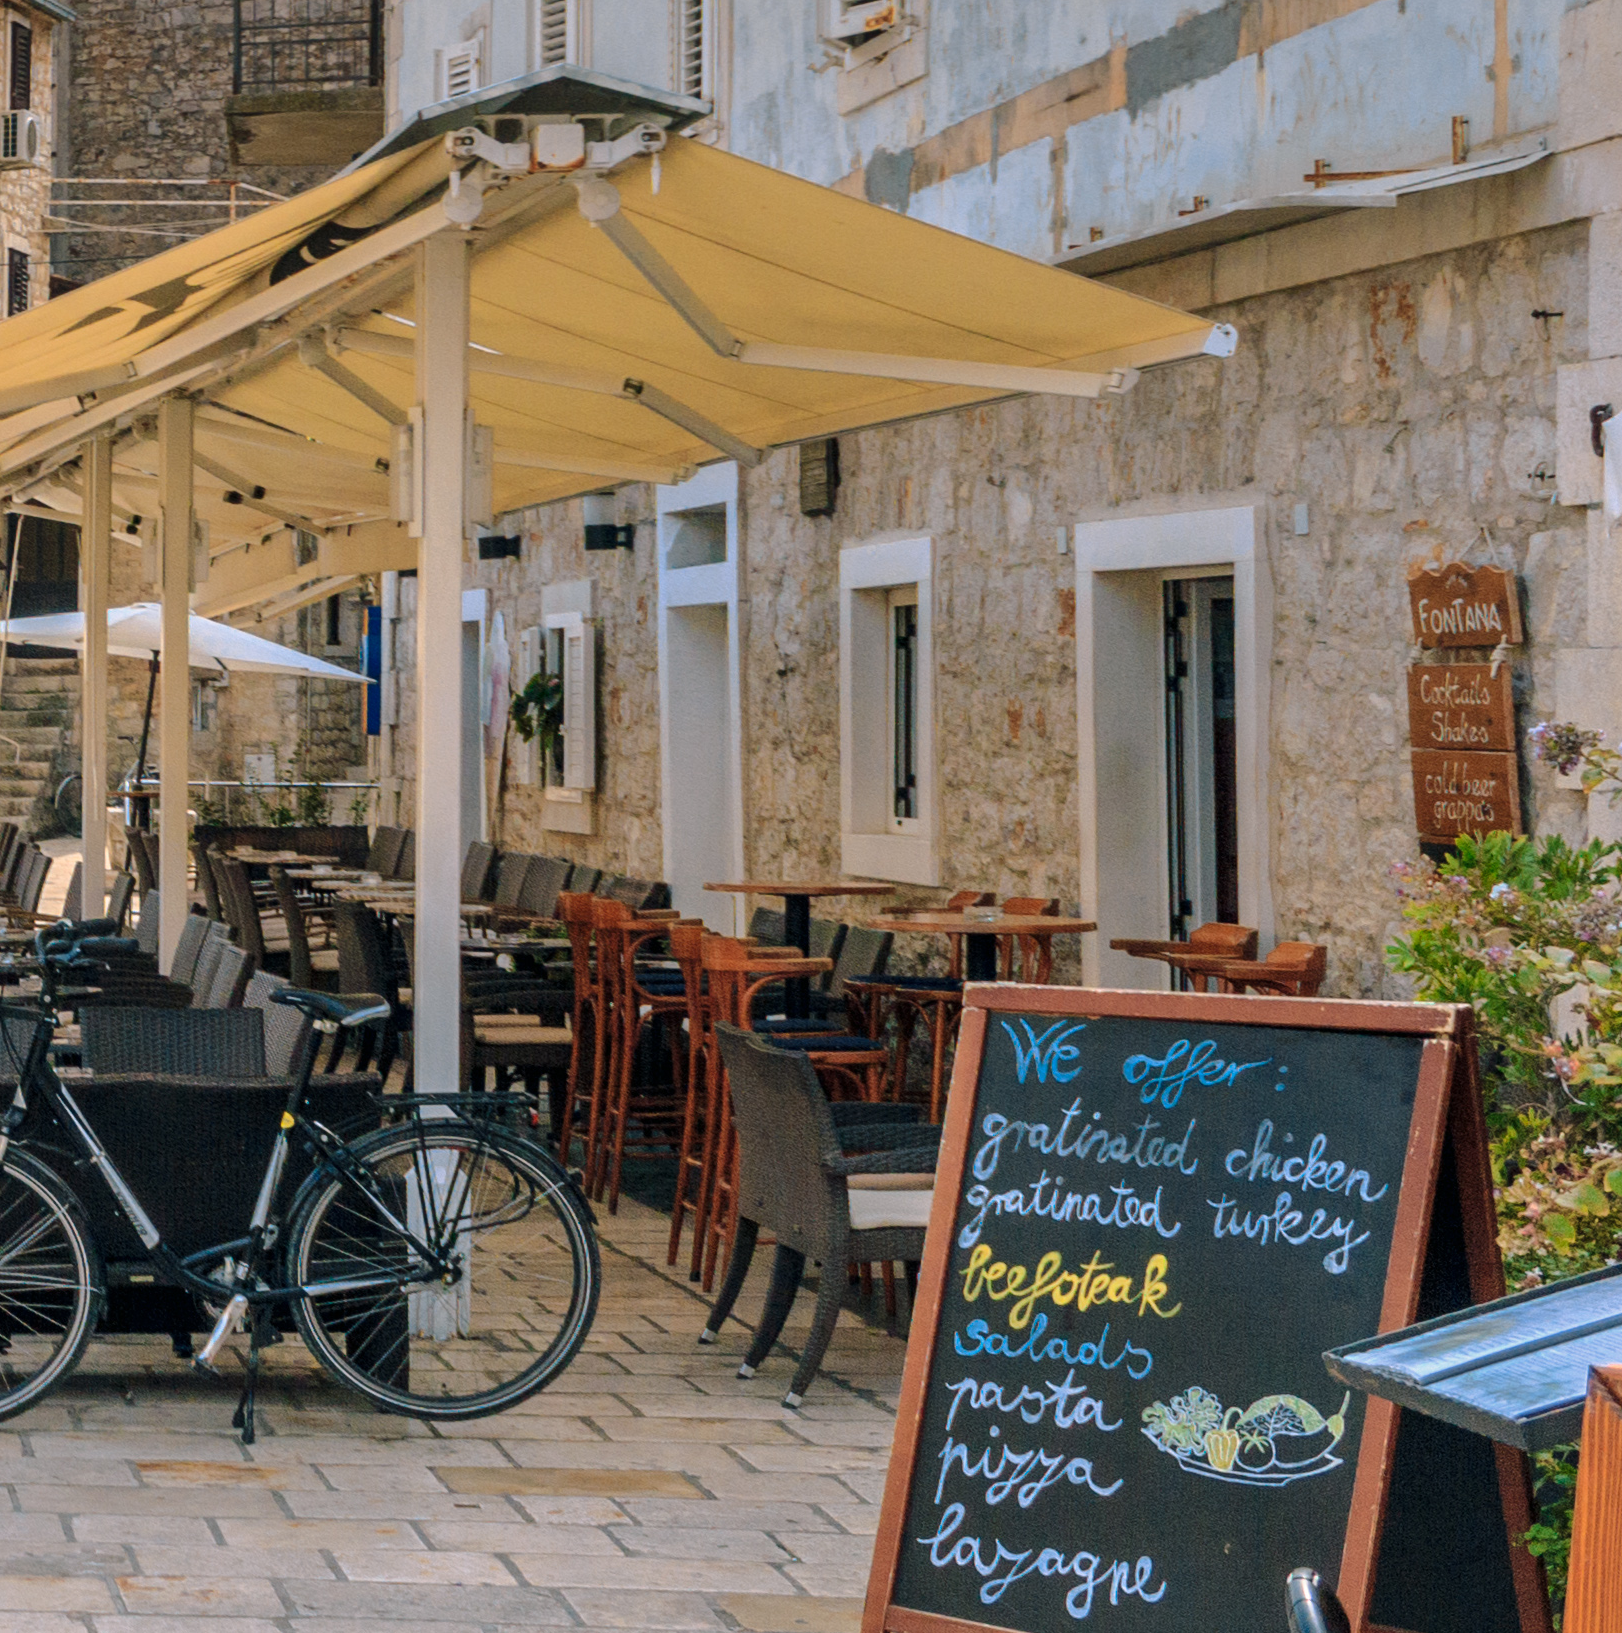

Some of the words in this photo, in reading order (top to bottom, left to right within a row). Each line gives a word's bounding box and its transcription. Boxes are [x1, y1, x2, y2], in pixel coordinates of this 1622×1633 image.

[1419, 598, 1502, 634] FONTANA
[1420, 672, 1491, 708] Cocktails
[1431, 711, 1490, 744] Shakes
[1425, 761, 1458, 795] cold
[1462, 762, 1497, 797] beer
[1000, 1017, 1087, 1084] We
[971, 1097, 1197, 1182] gratinated
[1225, 1118, 1389, 1203] chicken
[958, 1169, 1181, 1248] gratinated
[1206, 1191, 1371, 1275] turkey
[958, 1244, 1182, 1330] beefsteak
[945, 1369, 1123, 1431] pasta
[933, 1426, 1123, 1508] pizza
